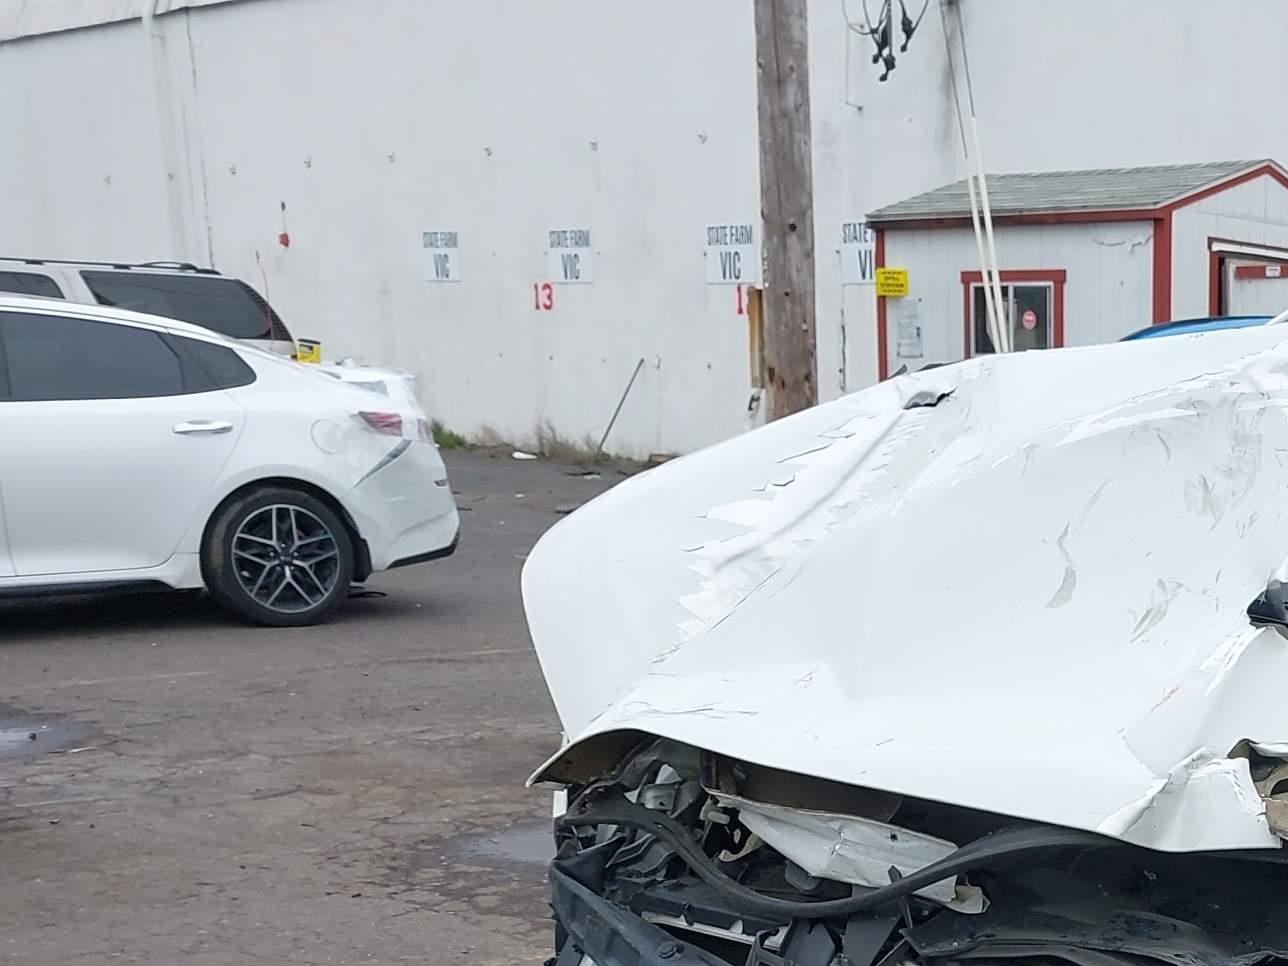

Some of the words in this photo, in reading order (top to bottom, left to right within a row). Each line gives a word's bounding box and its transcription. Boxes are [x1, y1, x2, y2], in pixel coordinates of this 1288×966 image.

[422, 232, 439, 248] STATE
[440, 232, 458, 248] FARM
[549, 230, 568, 248] STATE
[570, 230, 591, 248] FARM
[706, 226, 728, 246] STATE
[730, 226, 753, 245] FARM
[843, 223, 868, 244] STATE
[433, 253, 450, 278] VIC
[561, 253, 580, 280] VIC
[720, 251, 742, 280] VIC
[858, 250, 873, 279] VI
[534, 283, 553, 310] 13
